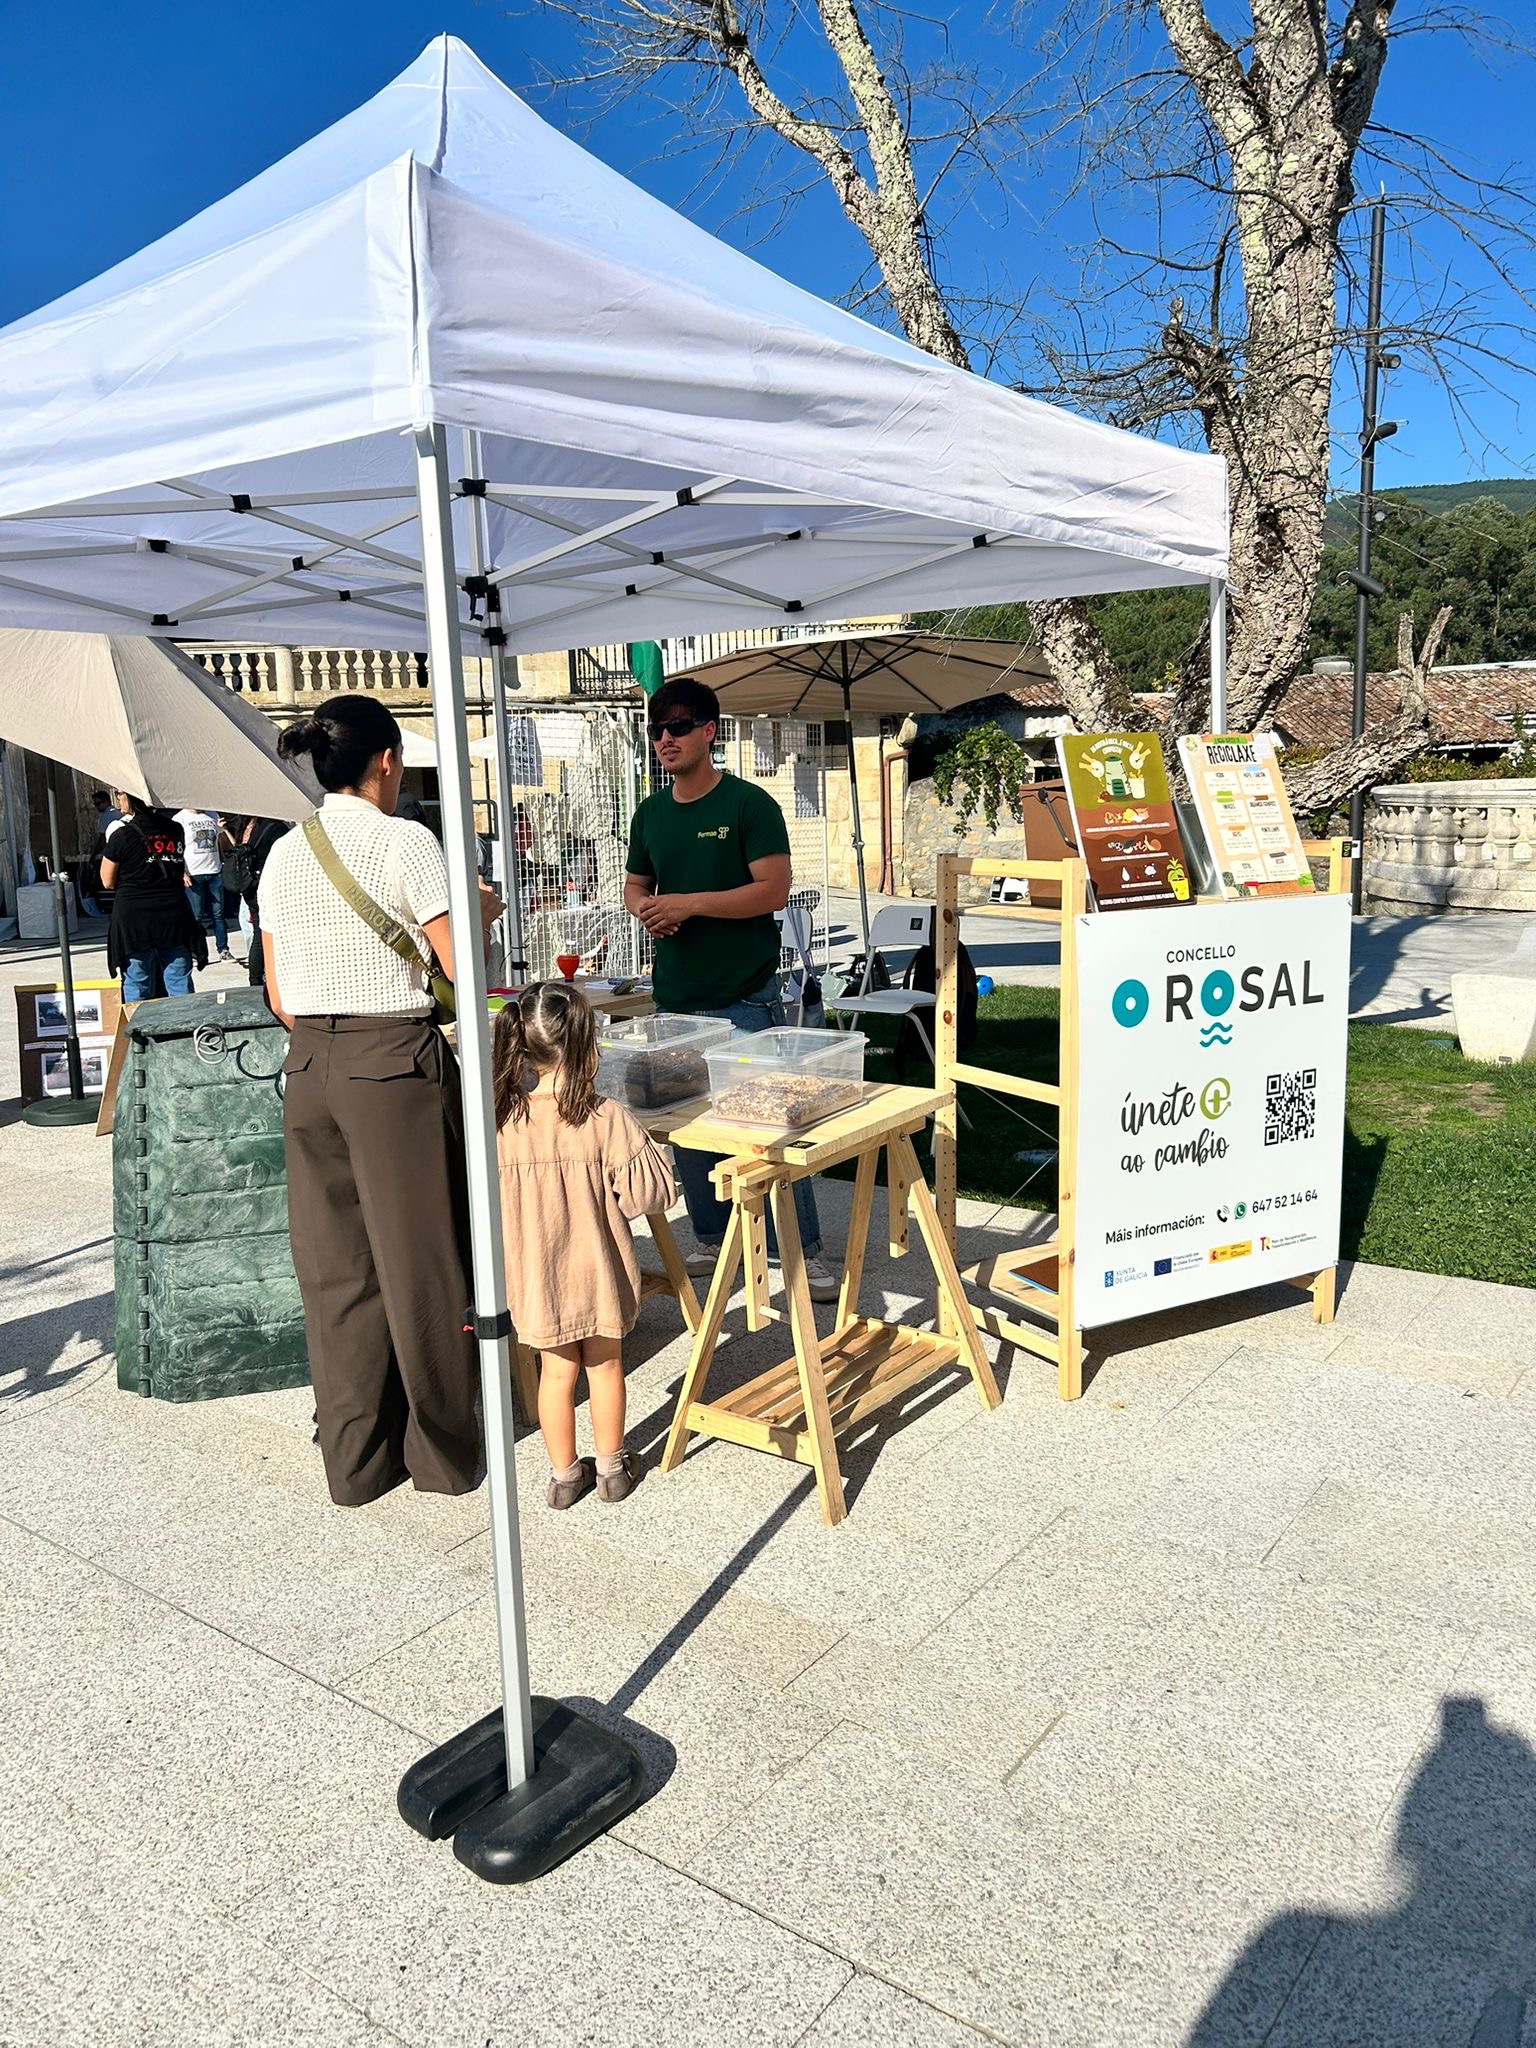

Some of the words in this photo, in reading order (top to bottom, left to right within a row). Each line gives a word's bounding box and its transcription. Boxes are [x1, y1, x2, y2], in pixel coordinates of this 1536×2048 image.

[1206, 744, 1257, 765] RECICLAXE
[1166, 944, 1236, 963] CONCELLO
[1112, 979, 1149, 1028] O
[1166, 960, 1324, 1023] ROSAL
[1121, 1081, 1196, 1136] únete
[1120, 1154, 1146, 1173] ao
[1154, 1128, 1230, 1172] cambio
[1252, 1198, 1273, 1214] 647
[1274, 1195, 1288, 1209] 52
[1290, 1192, 1303, 1206] 14
[1305, 1189, 1318, 1203] 64
[1105, 1228, 1132, 1244] Máis
[1135, 1214, 1205, 1238] información:
[1115, 1267, 1136, 1277] XUNTA
[1115, 1277, 1123, 1285] DE
[1124, 1271, 1148, 1283] GALICIA
